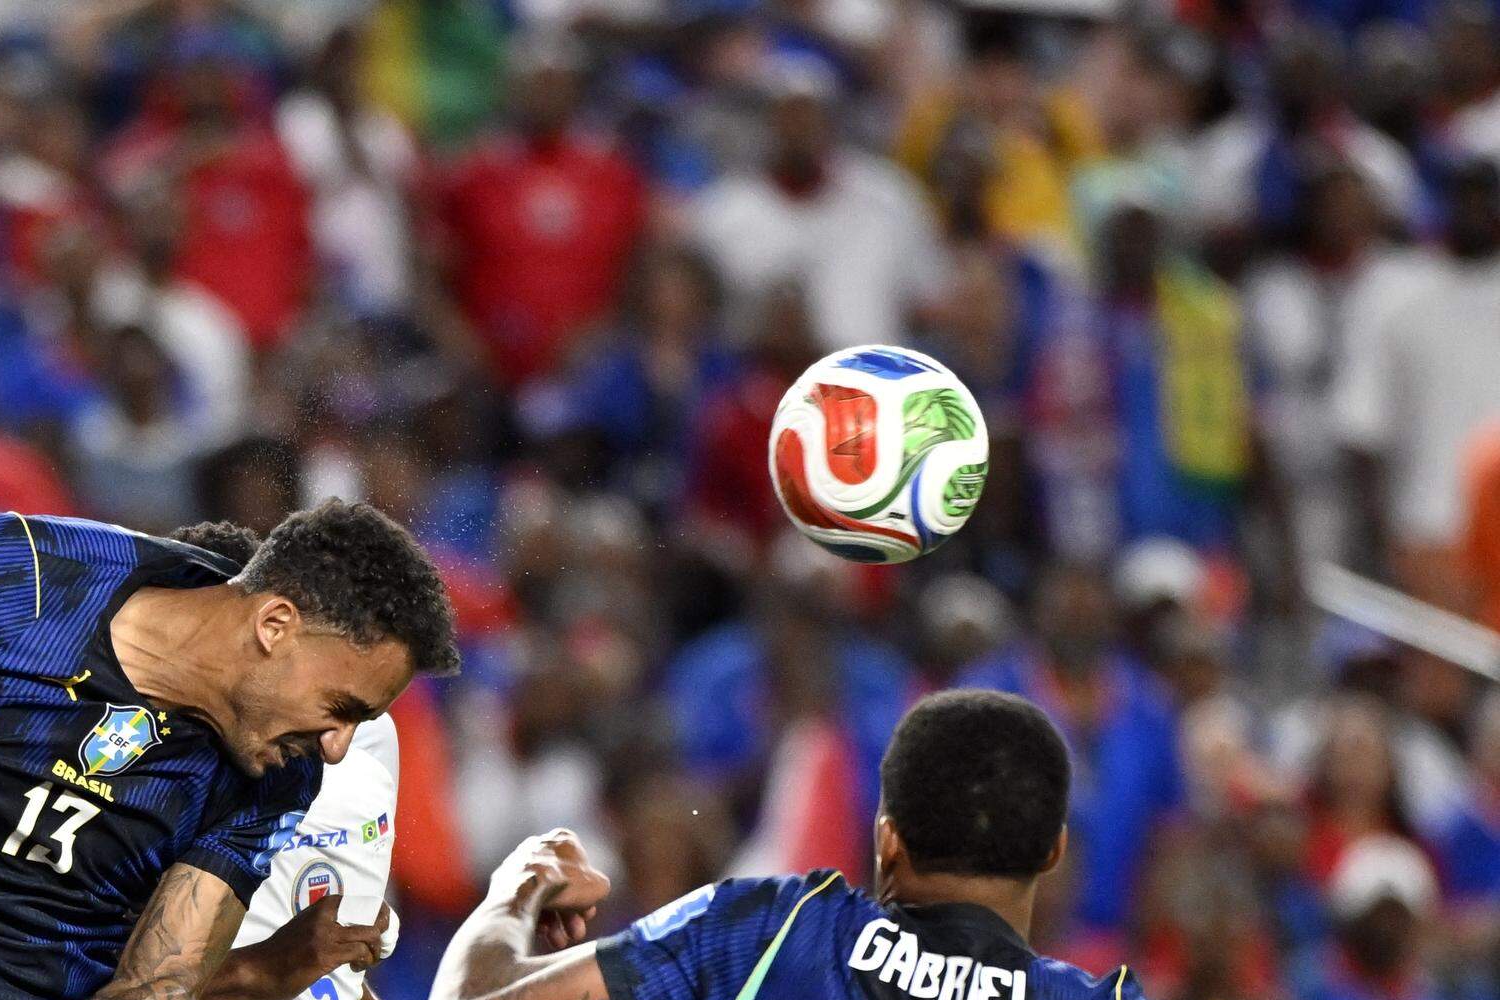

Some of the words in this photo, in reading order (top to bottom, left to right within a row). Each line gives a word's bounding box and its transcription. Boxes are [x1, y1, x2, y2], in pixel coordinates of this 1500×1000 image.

[108, 733, 130, 749] CBF
[51, 759, 114, 803] BRASIL
[1, 781, 102, 874] 13
[310, 876, 328, 885] HAITI
